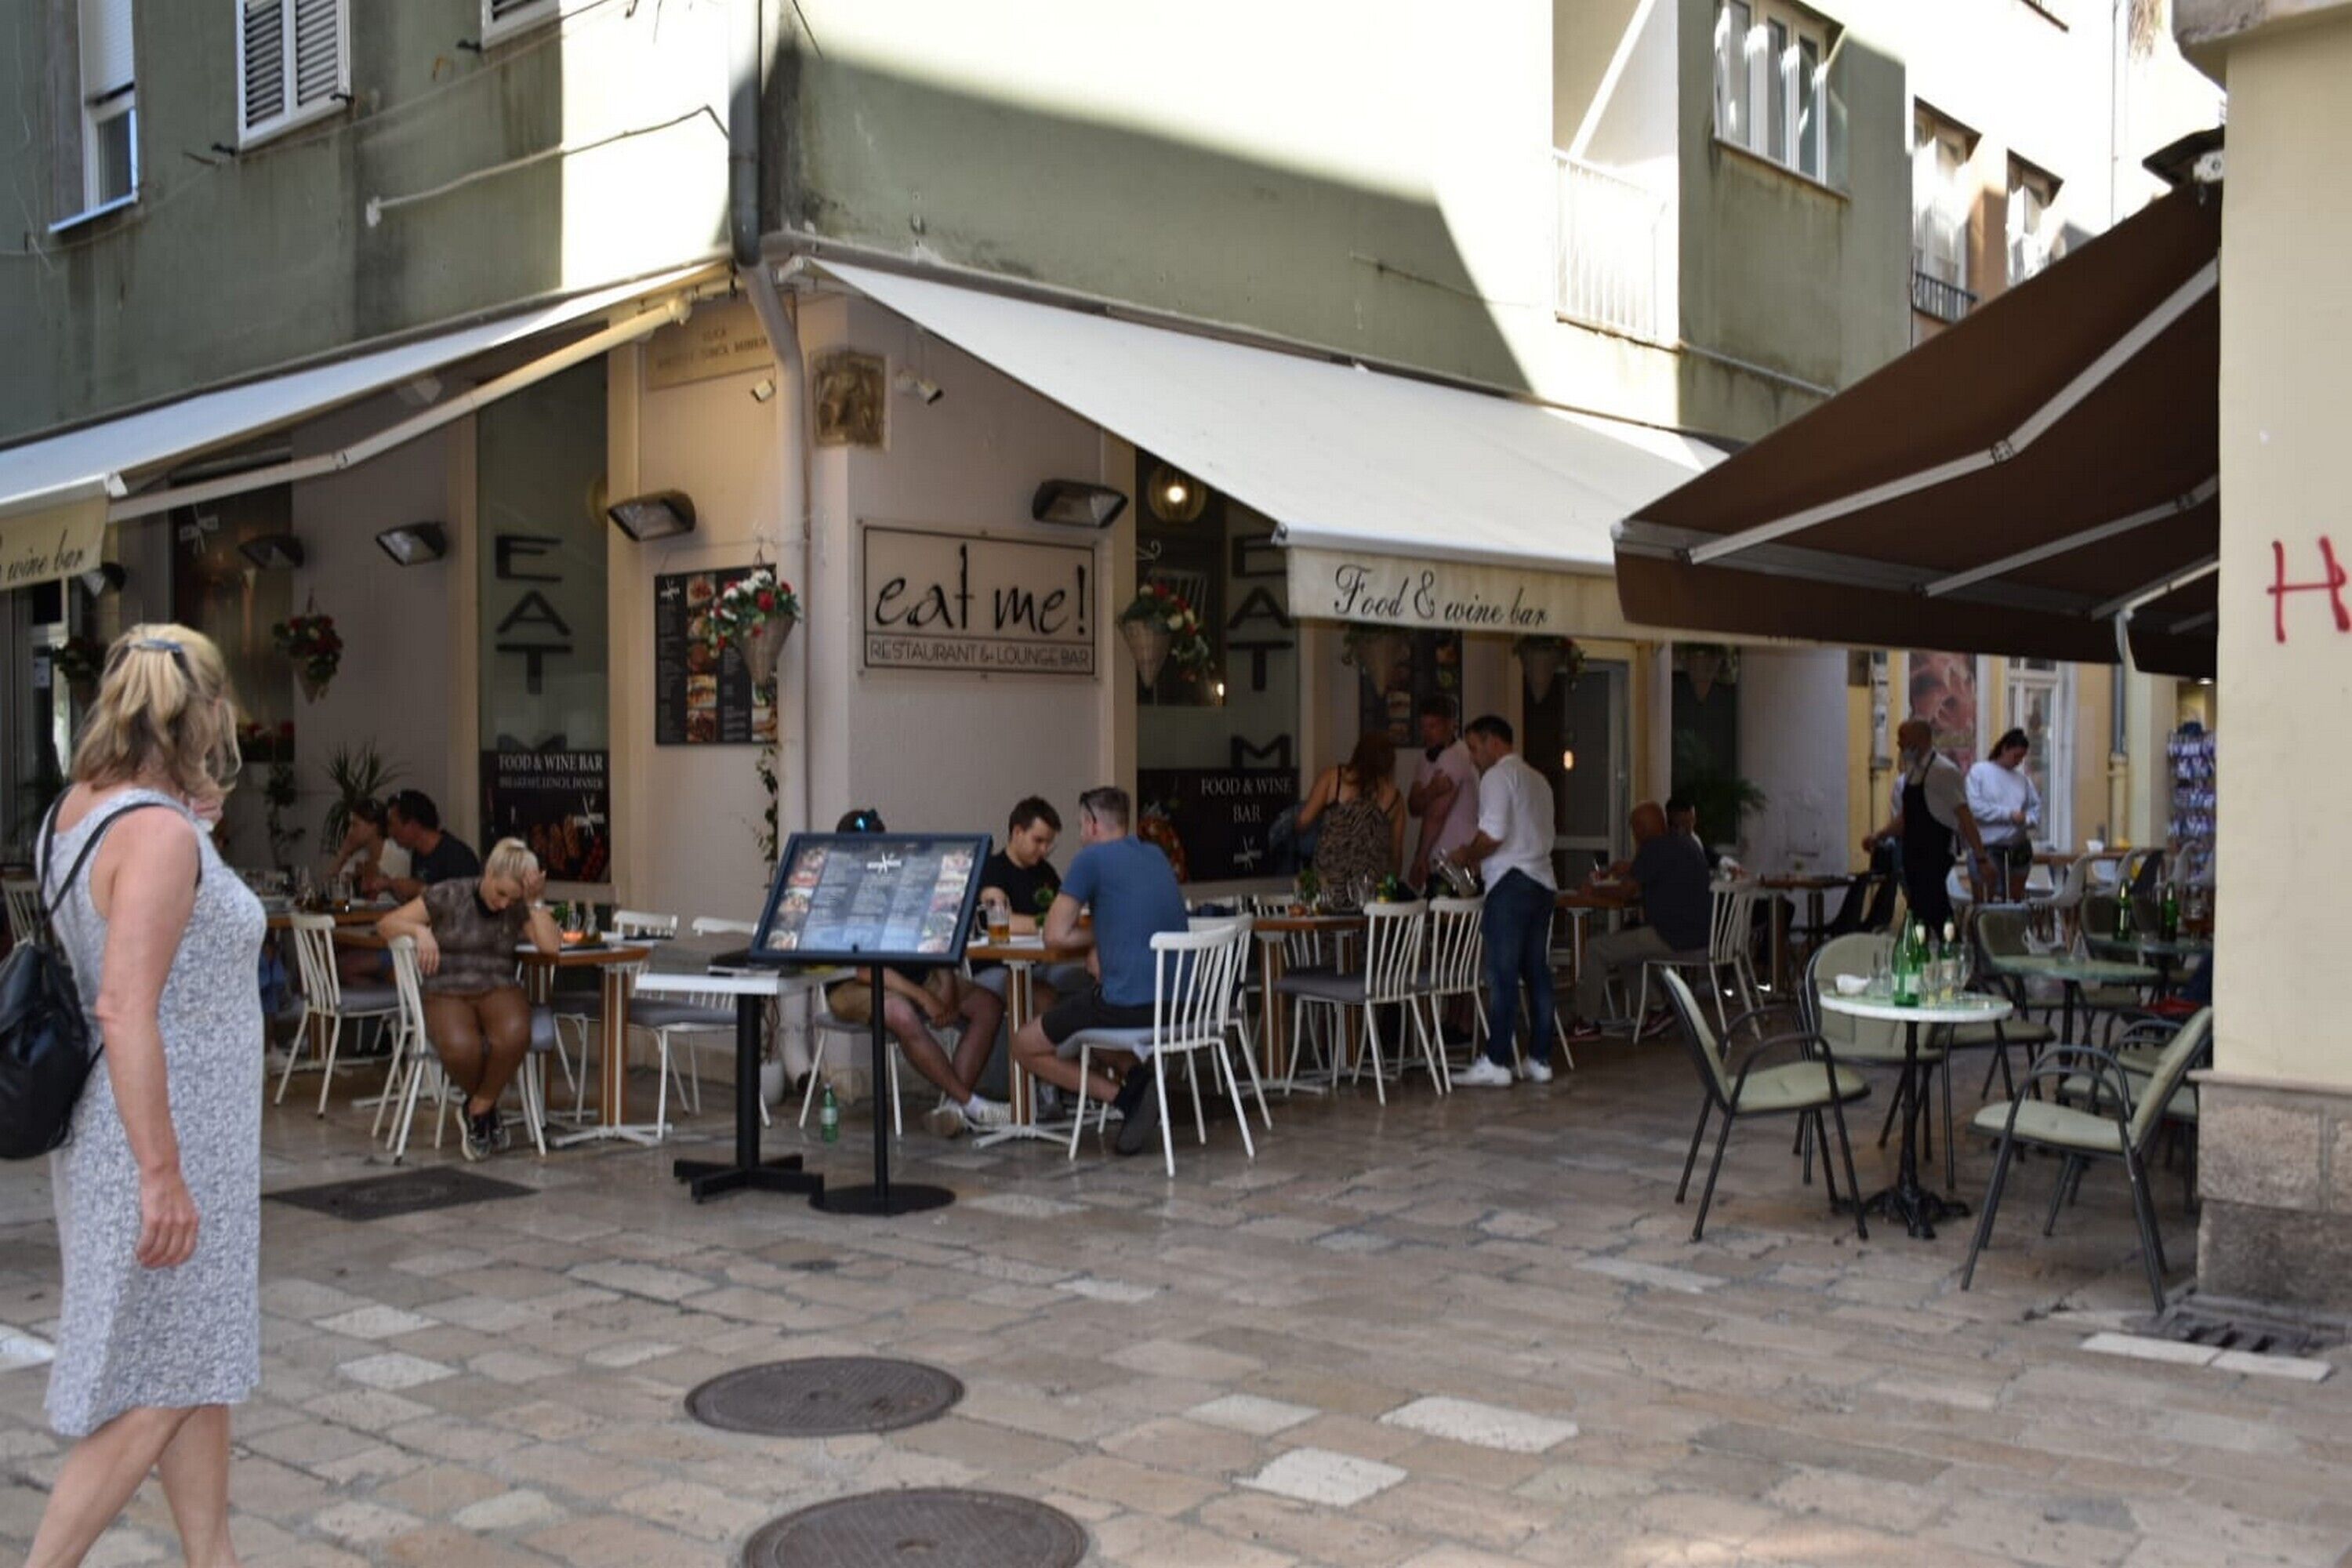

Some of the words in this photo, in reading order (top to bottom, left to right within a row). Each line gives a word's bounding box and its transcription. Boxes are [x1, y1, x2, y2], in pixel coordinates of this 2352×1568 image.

[7, 546, 47, 582] wine
[54, 528, 84, 572] bar
[875, 541, 975, 630] eat
[993, 564, 1087, 635] me!
[1334, 564, 1409, 618] Food
[1414, 569, 1436, 620] &
[1445, 593, 1503, 624] wine
[1510, 587, 1548, 626] bar
[495, 534, 573, 695] EAT
[869, 637, 977, 662] RESTAURANT
[996, 648, 1057, 666] LOUNGE
[1060, 651, 1090, 666] BAR
[499, 753, 531, 771] FOOD
[544, 753, 577, 772] WINE
[579, 753, 604, 771] BAR
[1201, 777, 1240, 796] FOOD
[1243, 777, 1254, 795] &
[1256, 777, 1291, 794] WINE
[1233, 804, 1261, 824] BAR
